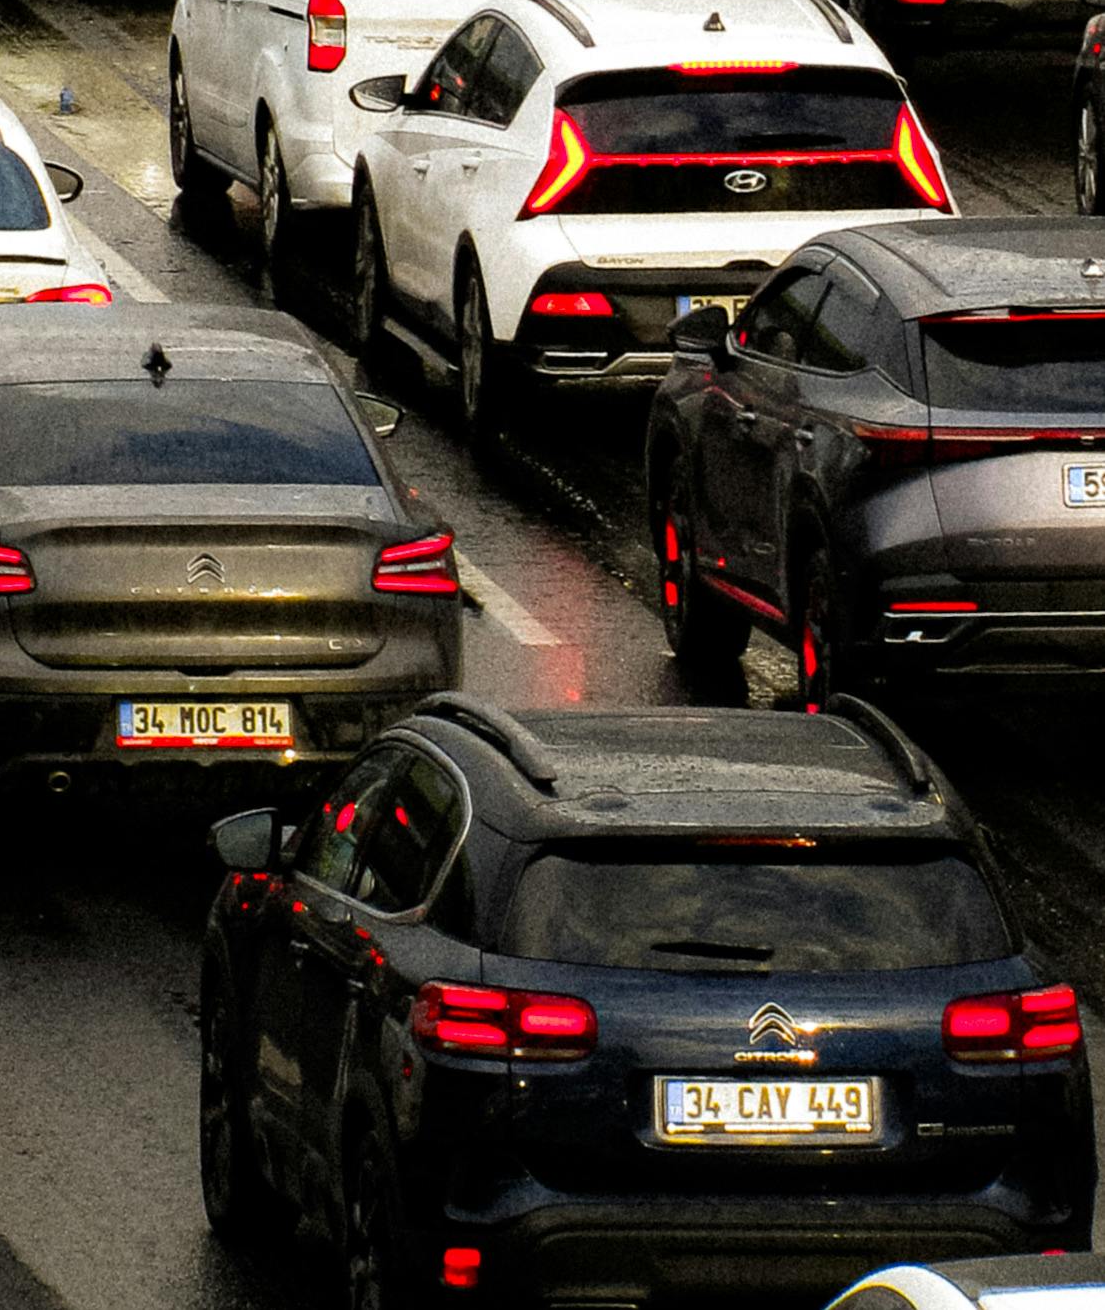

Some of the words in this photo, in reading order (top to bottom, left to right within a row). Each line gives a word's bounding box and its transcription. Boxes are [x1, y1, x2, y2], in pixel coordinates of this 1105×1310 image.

[134, 706, 165, 734] 34
[180, 706, 226, 734] MOC
[241, 706, 283, 734] 814
[685, 1086, 721, 1119] 34
[738, 1086, 792, 1118] CAY
[808, 1086, 862, 1118] 449
